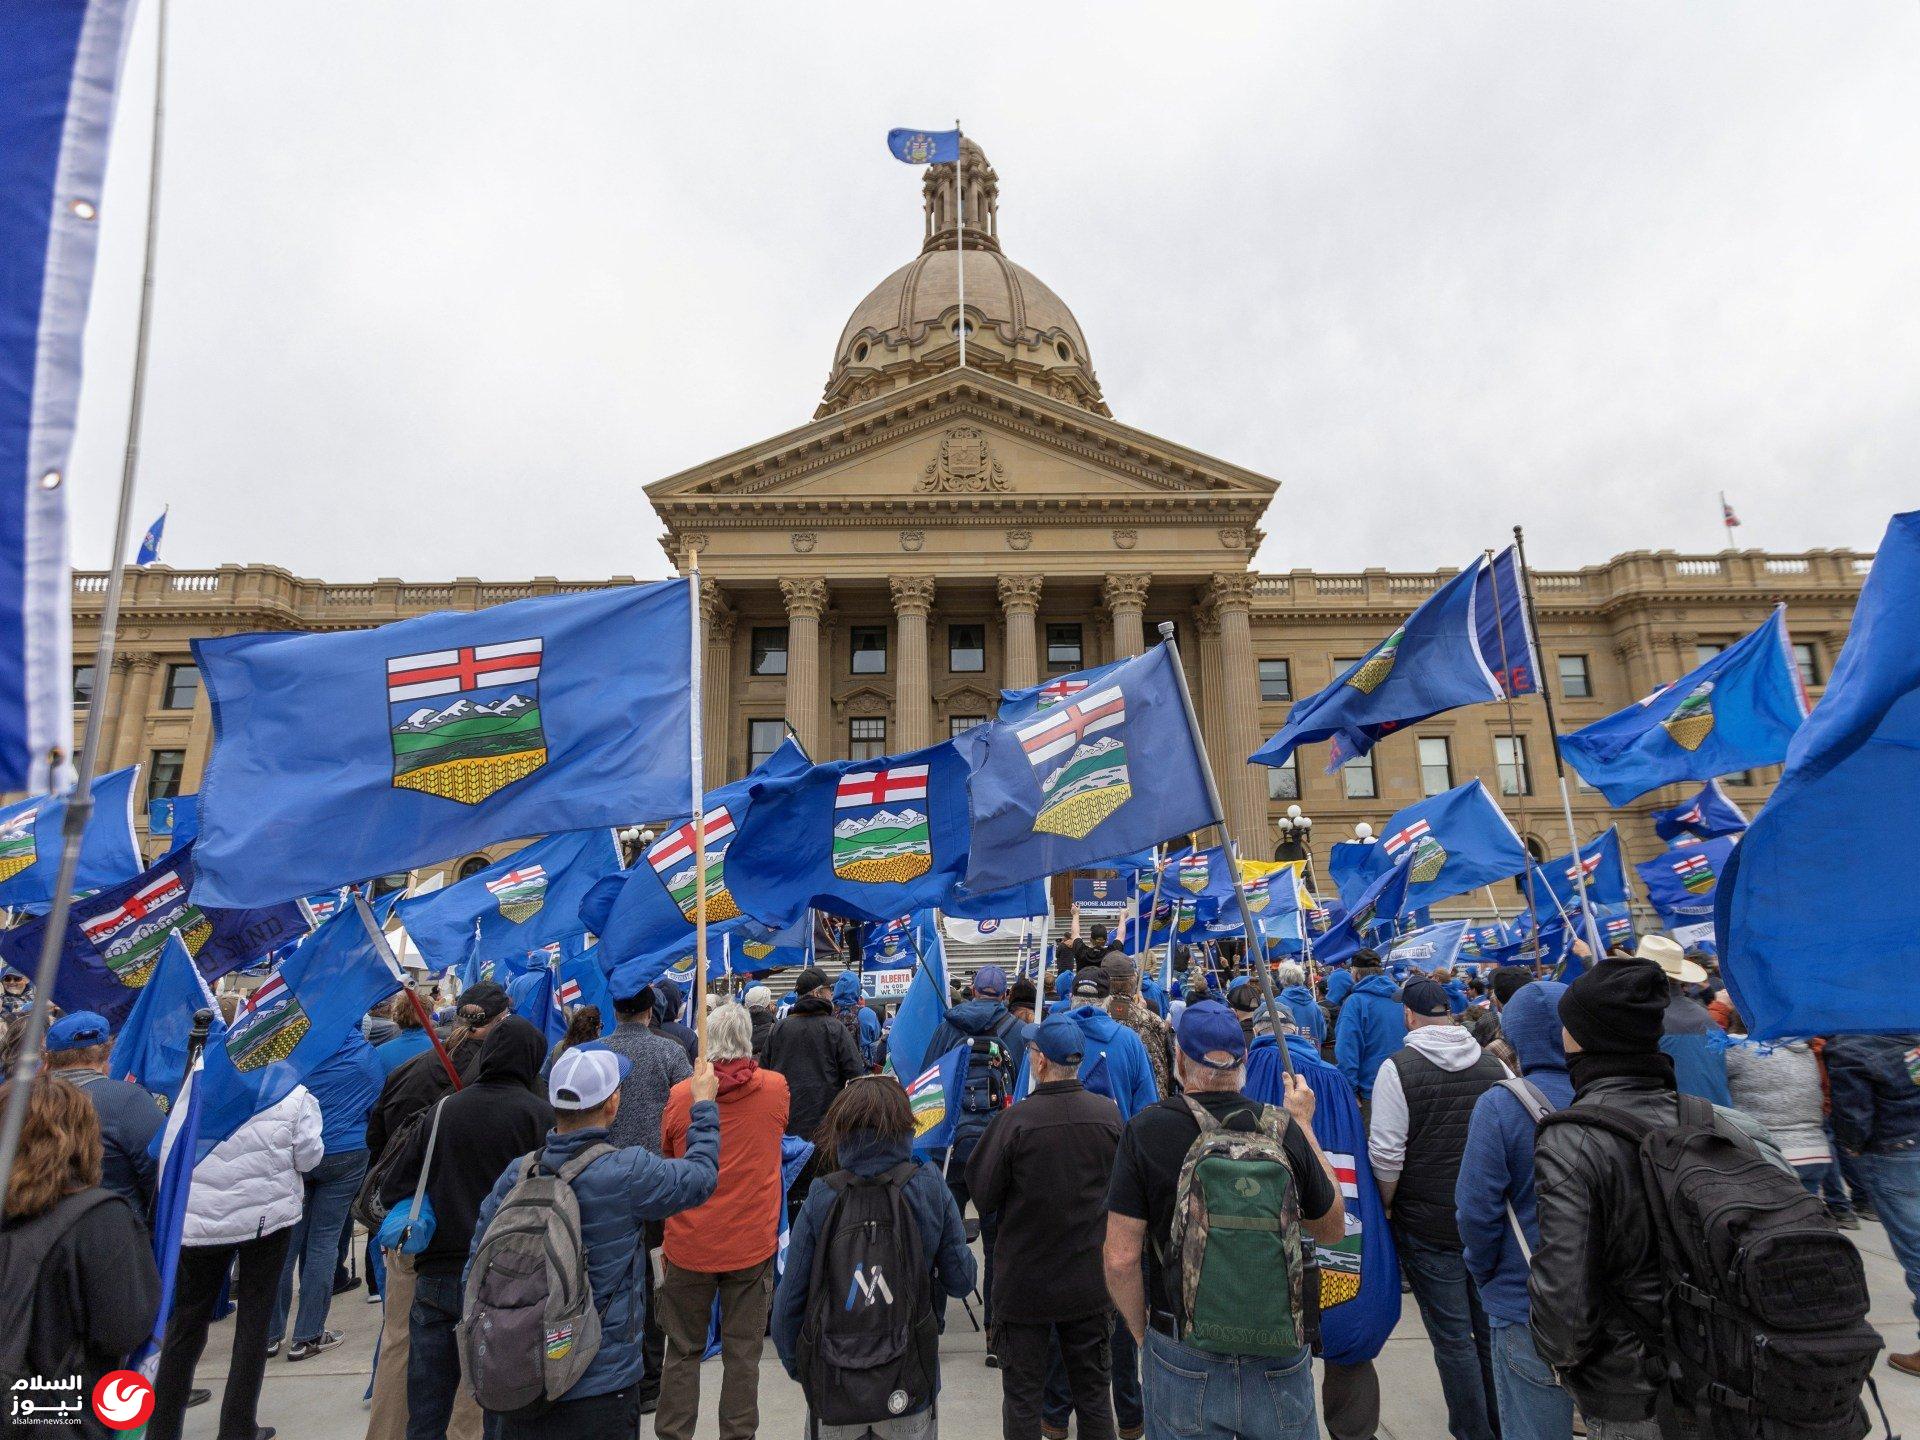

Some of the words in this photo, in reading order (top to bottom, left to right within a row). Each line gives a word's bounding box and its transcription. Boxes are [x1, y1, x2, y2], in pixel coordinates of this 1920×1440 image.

[880, 974, 910, 984] ALBERTA
[1194, 1320, 1256, 1344] MOSSY
[1257, 1328, 1297, 1347] OAK
